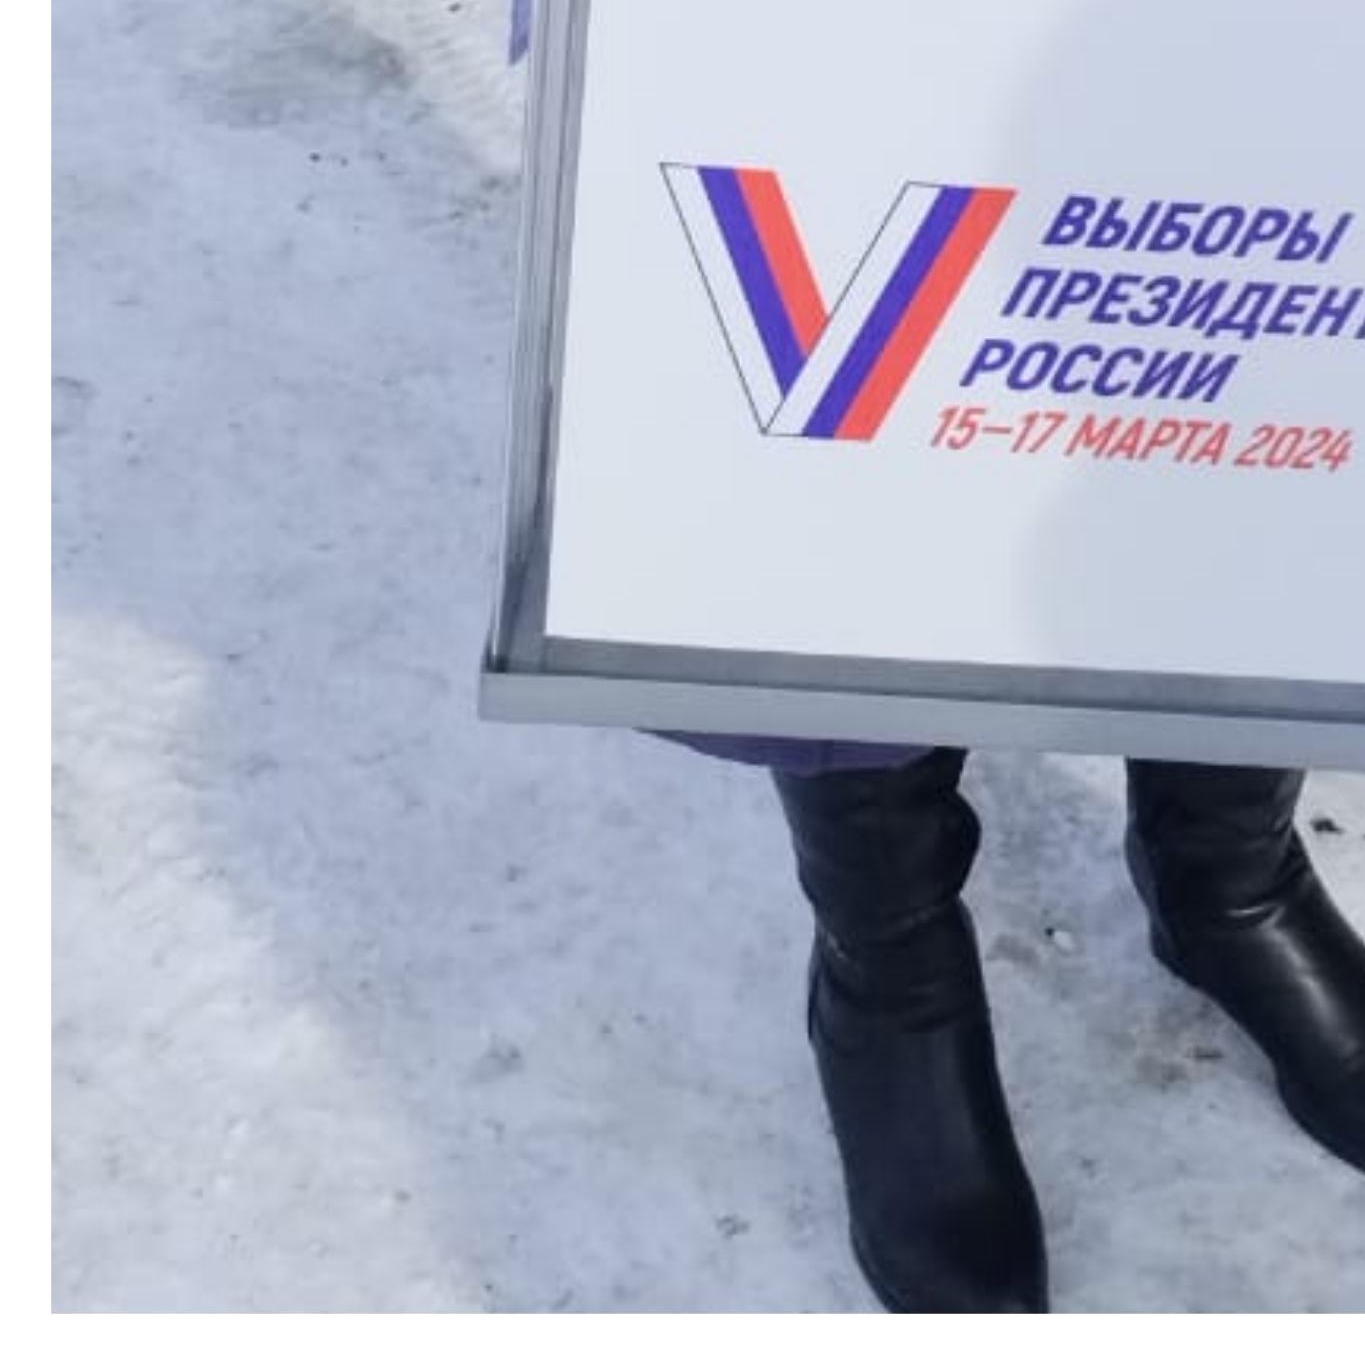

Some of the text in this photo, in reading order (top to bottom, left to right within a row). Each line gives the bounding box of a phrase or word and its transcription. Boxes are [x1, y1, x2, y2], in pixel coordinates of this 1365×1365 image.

[1042, 195, 1356, 264] ВЫБОРЫ
[960, 338, 1239, 403] РОССИИ
[1065, 414, 1232, 466] МАРТА
[1235, 425, 1356, 473] 2024
